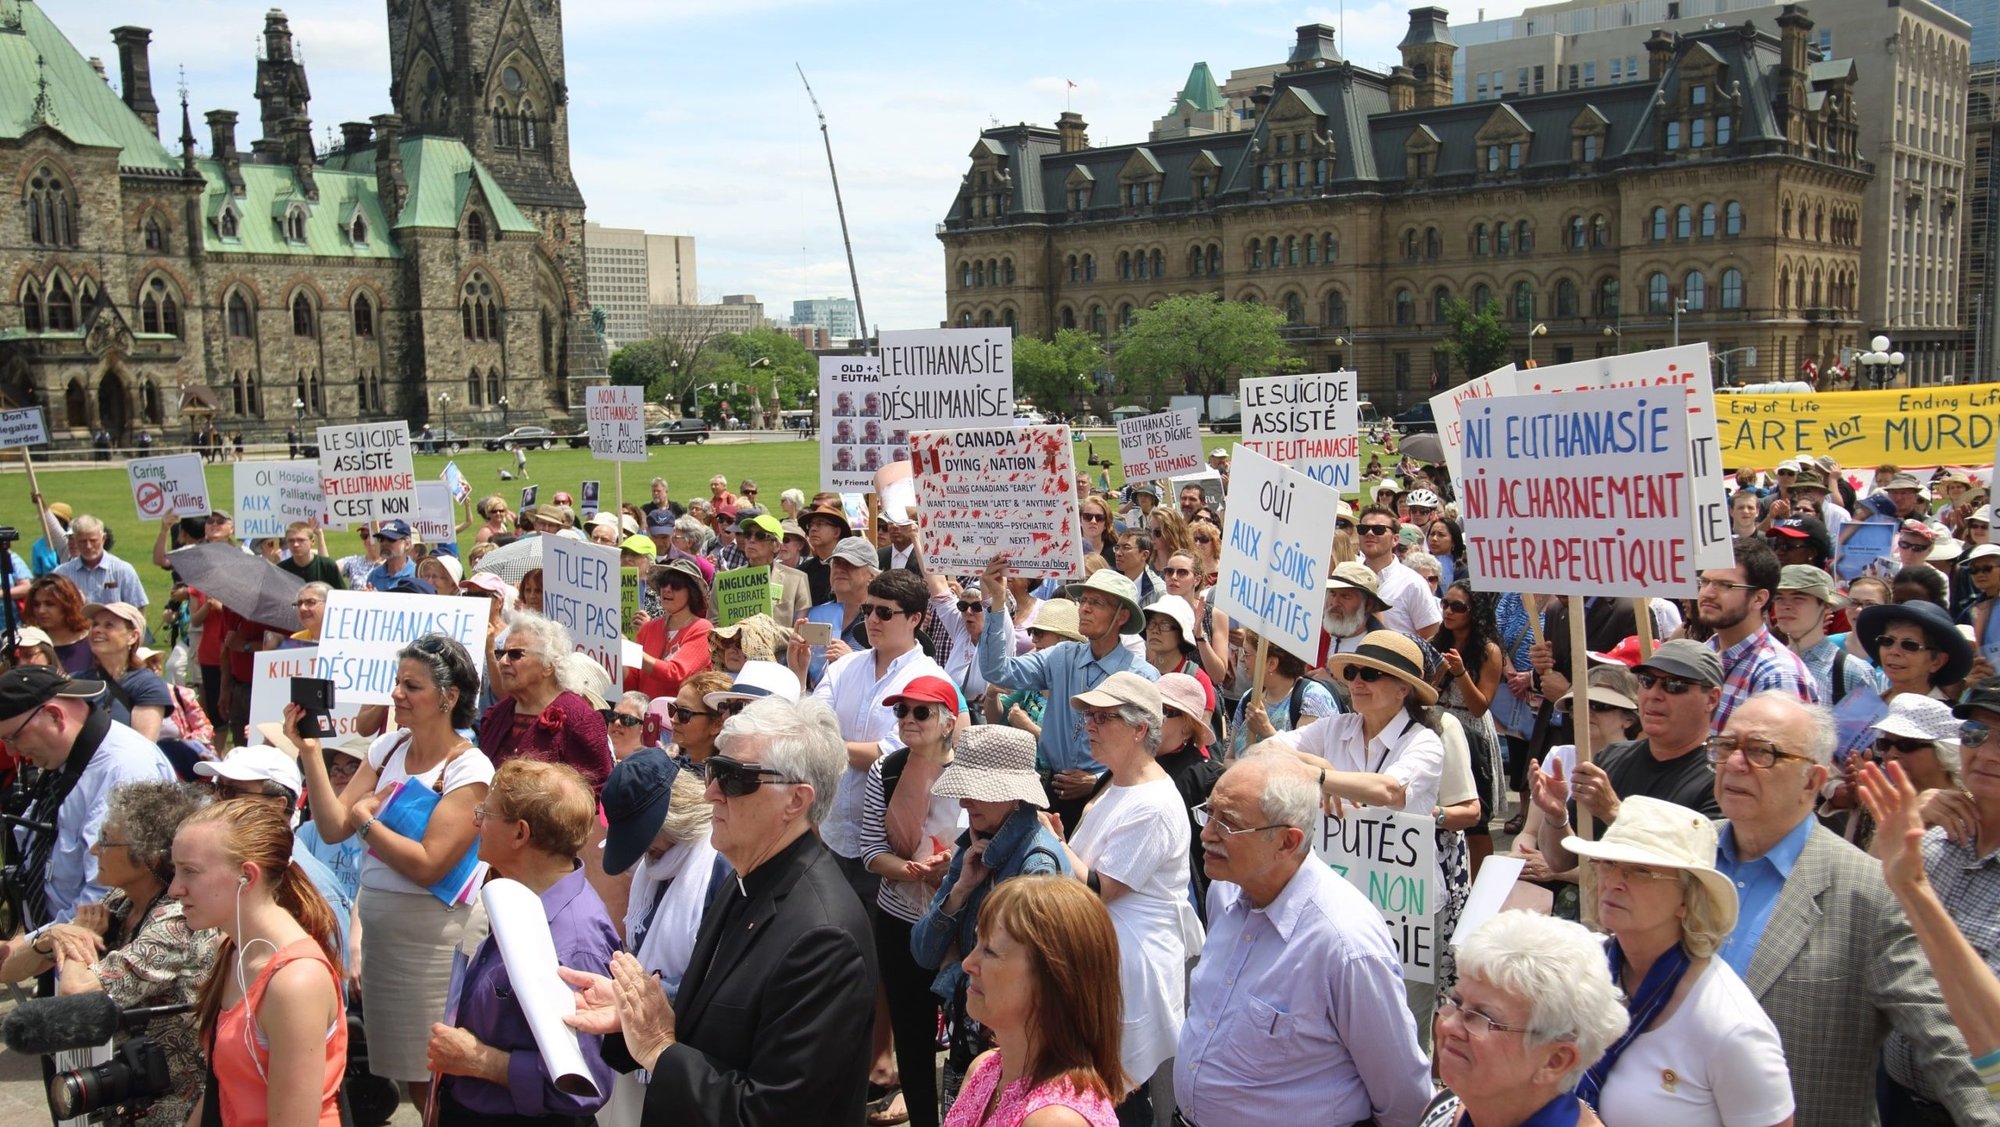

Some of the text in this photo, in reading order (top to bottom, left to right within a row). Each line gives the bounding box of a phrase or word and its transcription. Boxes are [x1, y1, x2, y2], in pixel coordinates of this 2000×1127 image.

[880, 338, 1004, 377] L'EUTHANASIE
[841, 364, 863, 373] OLD
[841, 374, 880, 382] EUTHA
[598, 389, 615, 404] NON
[1246, 376, 1348, 407] LE SUICIDE
[1899, 388, 2000, 411] Ending Lif
[882, 383, 1008, 421] DÉSHUMANISE
[1763, 401, 1779, 413] of
[1791, 399, 1820, 413] Life
[1120, 412, 1183, 435] L'EUTHANASIE
[1252, 403, 1336, 435] ASSISTÉ
[0, 423, 38, 435] legalize
[601, 422, 629, 437] ET AU
[1146, 432, 1162, 446] PAS
[1165, 426, 1192, 442] DIGNE
[1465, 399, 1669, 460] NI EUTHANASIE
[1823, 415, 1862, 443] NOT
[1885, 413, 1998, 452] MURD
[4, 435, 39, 445] murder
[323, 428, 405, 451] LE SUICIDE
[617, 436, 643, 455] ASSISTÉ
[955, 430, 1016, 448] CANADA
[333, 448, 393, 472] ASSISTÉ
[1148, 445, 1169, 460] DES
[133, 463, 166, 480] Caring
[945, 456, 1036, 472] DYING NATION
[1154, 454, 1198, 473] HUMAINS
[279, 470, 314, 485] Hospice
[832, 479, 843, 487] My
[1307, 463, 1350, 487] NON
[159, 480, 178, 493] NOT
[280, 487, 322, 502] Palliative
[946, 483, 1036, 494] KILLING CANADIANS "EARLY"
[1464, 467, 1488, 519] NI
[1496, 472, 1684, 519] ACHARNEMENT
[172, 493, 205, 510] Killing
[242, 495, 271, 512] AUX
[281, 504, 317, 517] Care for
[333, 496, 409, 517] C'EST NON
[927, 500, 947, 508] WANT
[956, 500, 969, 509] KILL
[970, 499, 989, 507] THEM
[990, 499, 1012, 507] "LATE"
[1014, 499, 1019, 507] &
[1022, 499, 1060, 508] "ANYTIME"
[1259, 480, 1295, 524] OUI
[937, 520, 970, 529] DEMENTIA
[979, 536, 999, 545] "YOU"
[1009, 536, 1030, 545] NEXT?
[929, 556, 938, 564] Go
[1230, 518, 1317, 591] AUX SOINS
[1470, 525, 1687, 588] THÉRAPEUTIQUE
[553, 549, 608, 593] TUER
[718, 572, 769, 592] ANGLICANS
[723, 588, 766, 605] CELEBRATE
[1230, 569, 1312, 642] PALLIATIFS
[727, 603, 763, 620] PROTECT
[586, 603, 618, 640] PAS
[268, 659, 303, 679] KILL
[316, 650, 396, 693] DÉSHU
[1323, 813, 1420, 867] PUTÉS
[1369, 870, 1425, 916] NON
